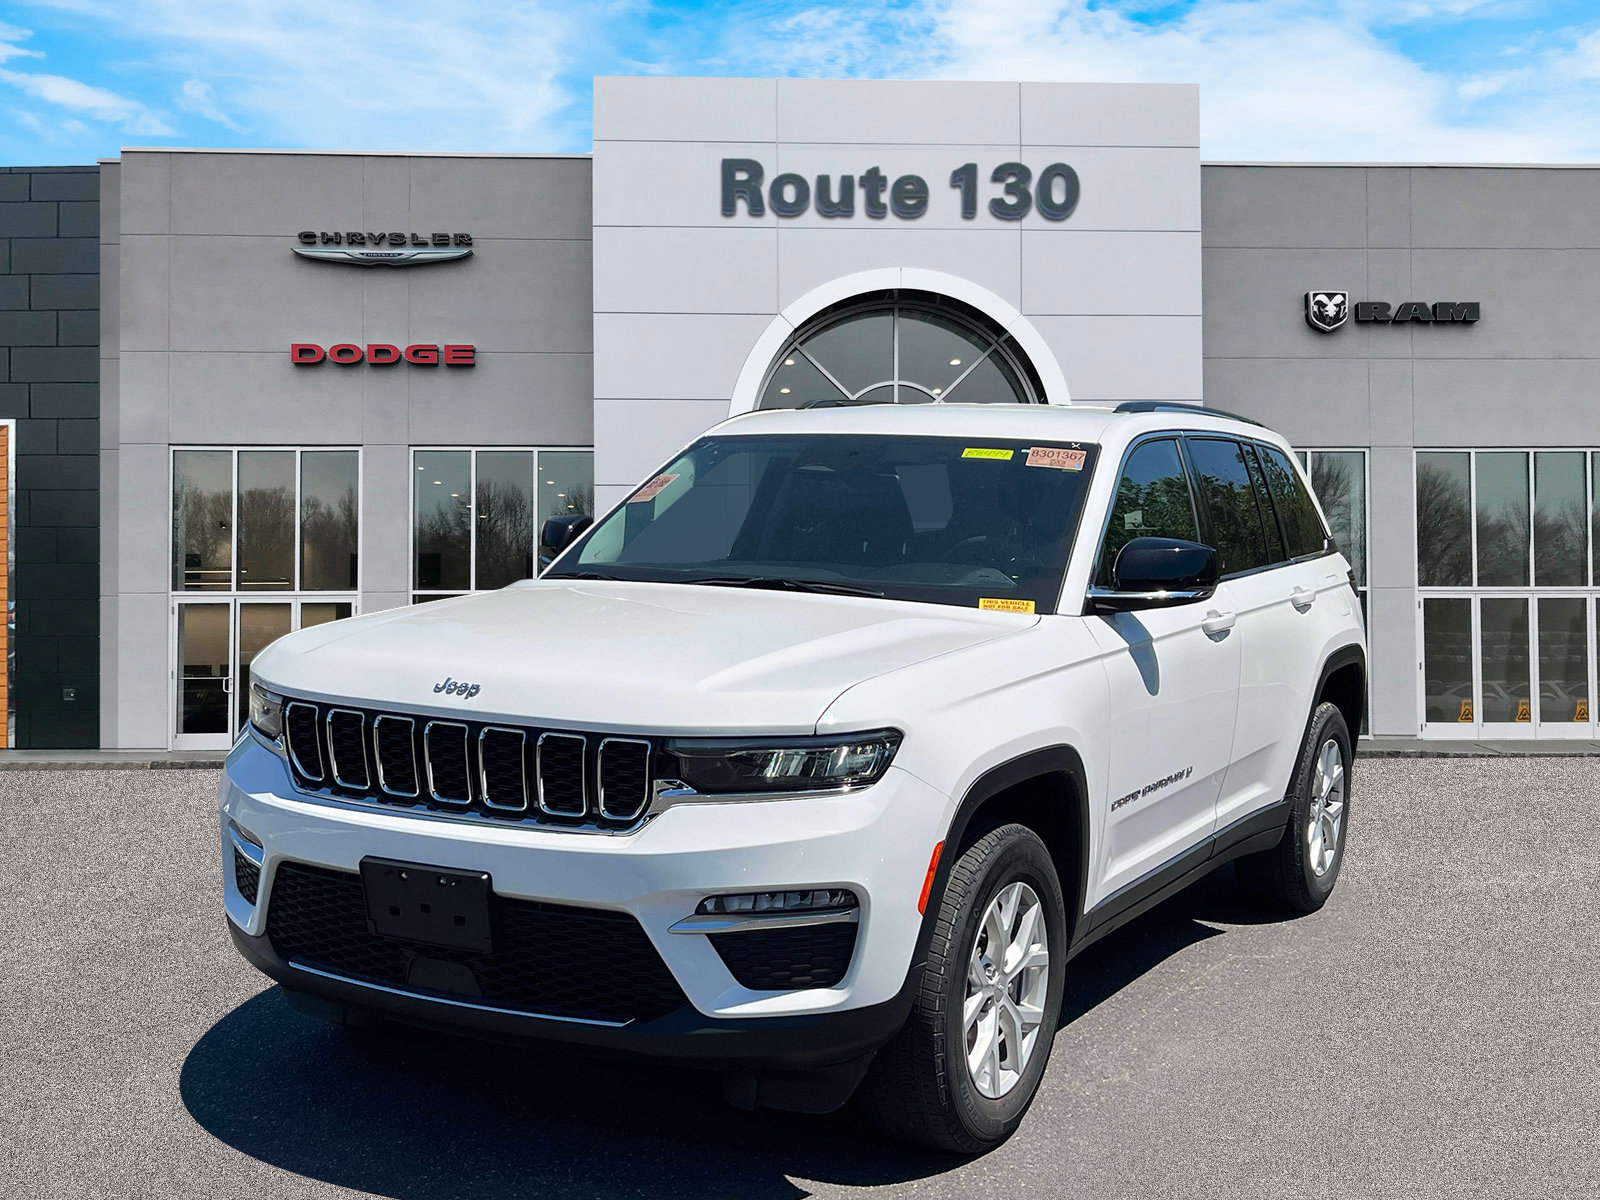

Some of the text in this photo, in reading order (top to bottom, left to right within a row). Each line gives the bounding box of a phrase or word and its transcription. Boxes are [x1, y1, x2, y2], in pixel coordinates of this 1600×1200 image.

[721, 158, 1080, 221] Route 130
[298, 231, 473, 246] CHRYSLER
[1355, 301, 1480, 325] RAM
[291, 343, 476, 366] DODGE
[1031, 449, 1085, 461] 8301367
[433, 677, 481, 700] Jeep
